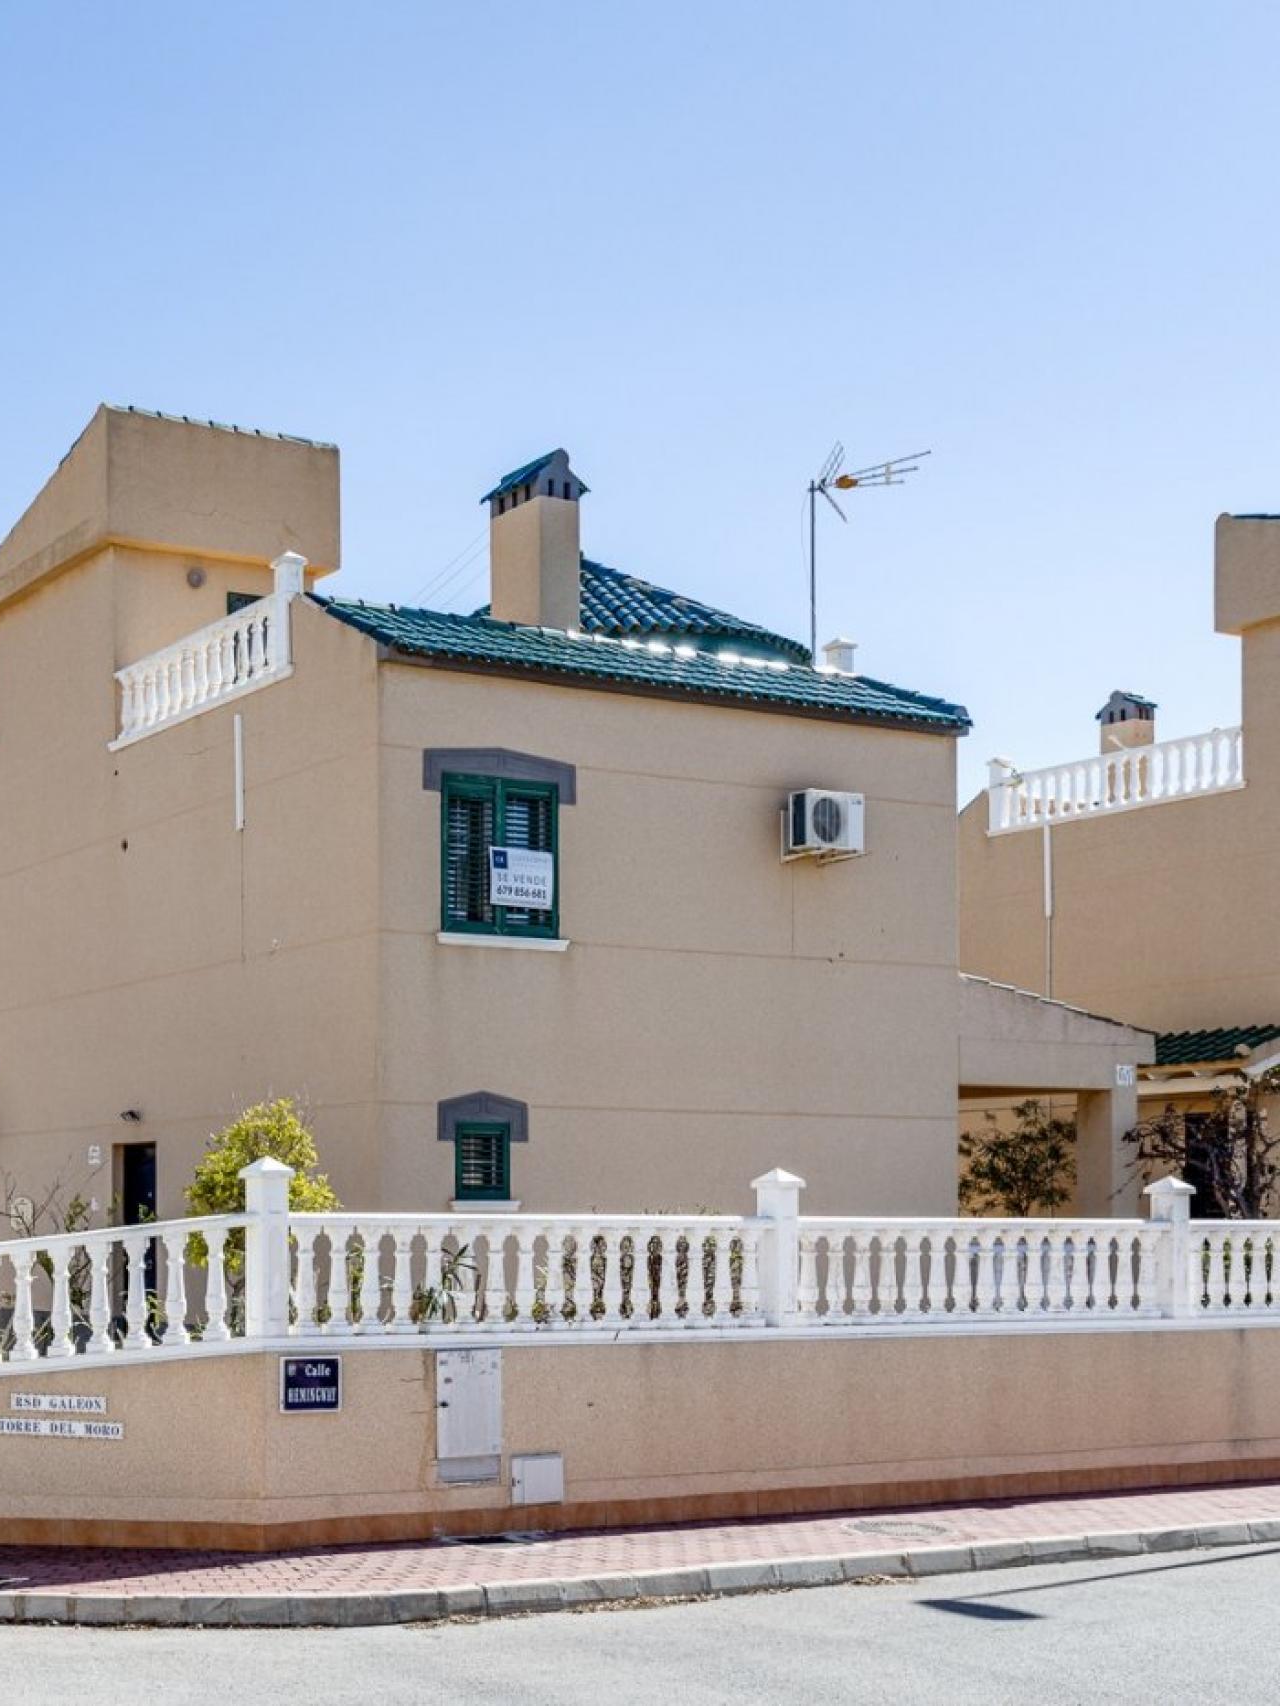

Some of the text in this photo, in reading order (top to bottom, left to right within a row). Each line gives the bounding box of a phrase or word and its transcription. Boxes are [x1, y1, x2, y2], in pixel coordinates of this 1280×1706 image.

[496, 872, 547, 887] SE VENDE
[496, 885, 513, 896] 679
[304, 1363, 331, 1377] Calle
[15, 1396, 41, 1407] RSD
[0, 1420, 120, 1436] TORRE DEL MORO
